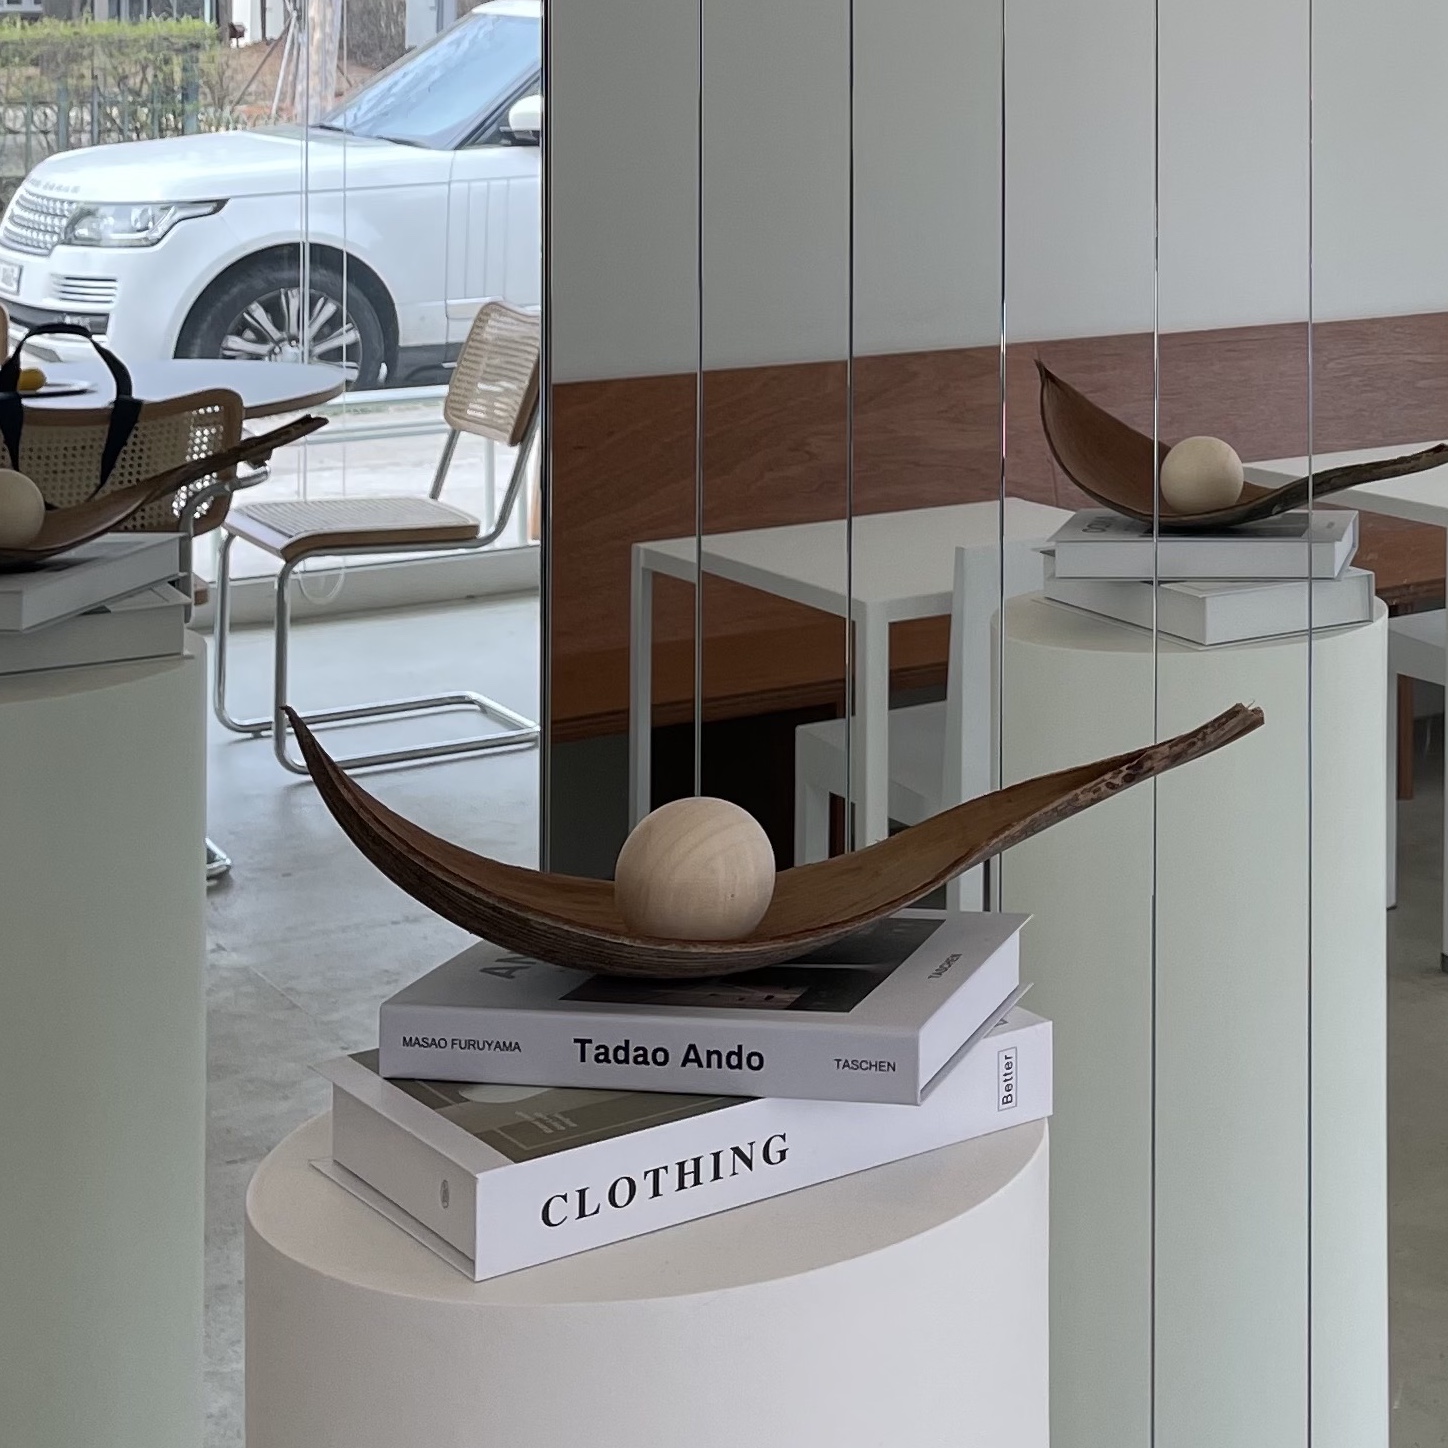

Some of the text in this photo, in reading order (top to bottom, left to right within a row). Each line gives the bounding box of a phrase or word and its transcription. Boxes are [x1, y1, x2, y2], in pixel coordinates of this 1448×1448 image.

[402, 1035, 522, 1053] MASAO FURUYAMA
[573, 1038, 765, 1071] Tadao Ando
[833, 1058, 896, 1073] TASCHEN
[1001, 1054, 1014, 1105] Better
[540, 1132, 790, 1228] CLOTHING
